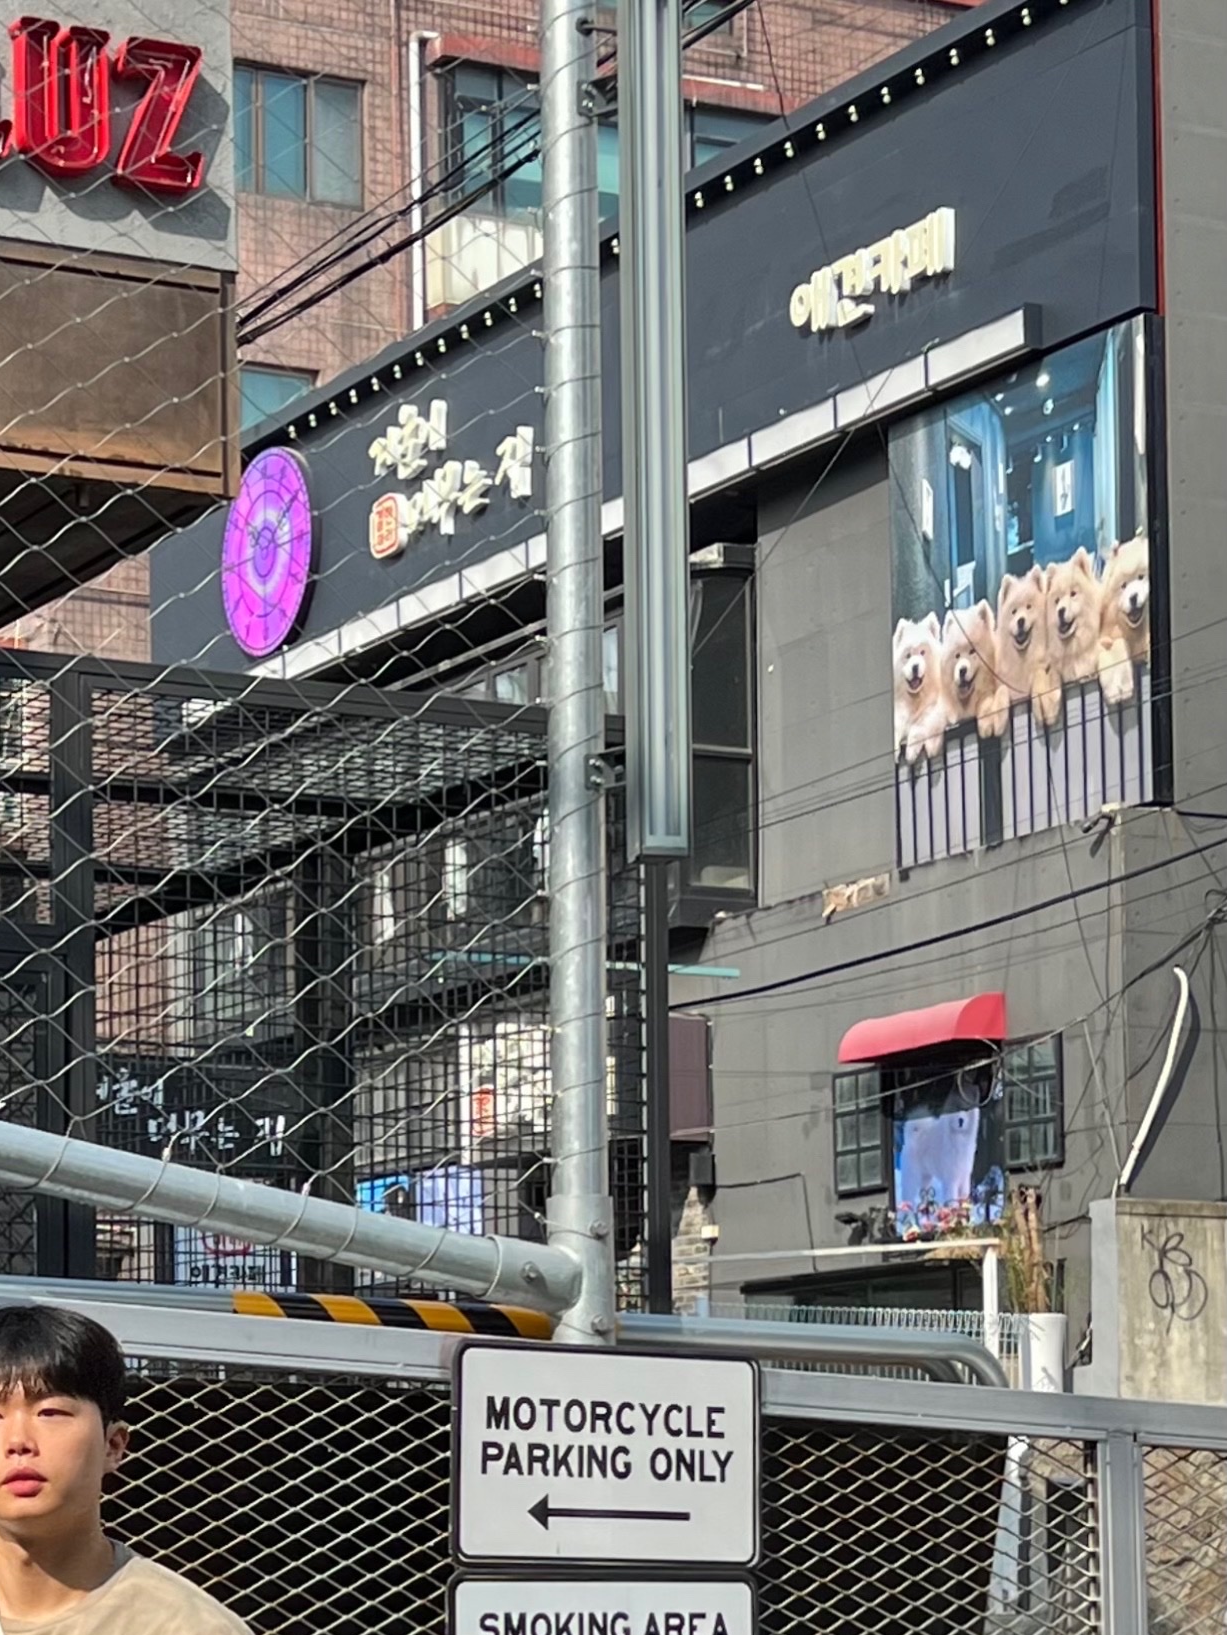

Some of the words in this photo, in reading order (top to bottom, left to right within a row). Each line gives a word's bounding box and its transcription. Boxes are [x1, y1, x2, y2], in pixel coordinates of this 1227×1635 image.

[790, 206, 956, 332] 애견카페
[485, 1395, 726, 1439] MOTORCYCLE
[480, 1440, 632, 1480] PARKING
[649, 1447, 735, 1483] ONLY
